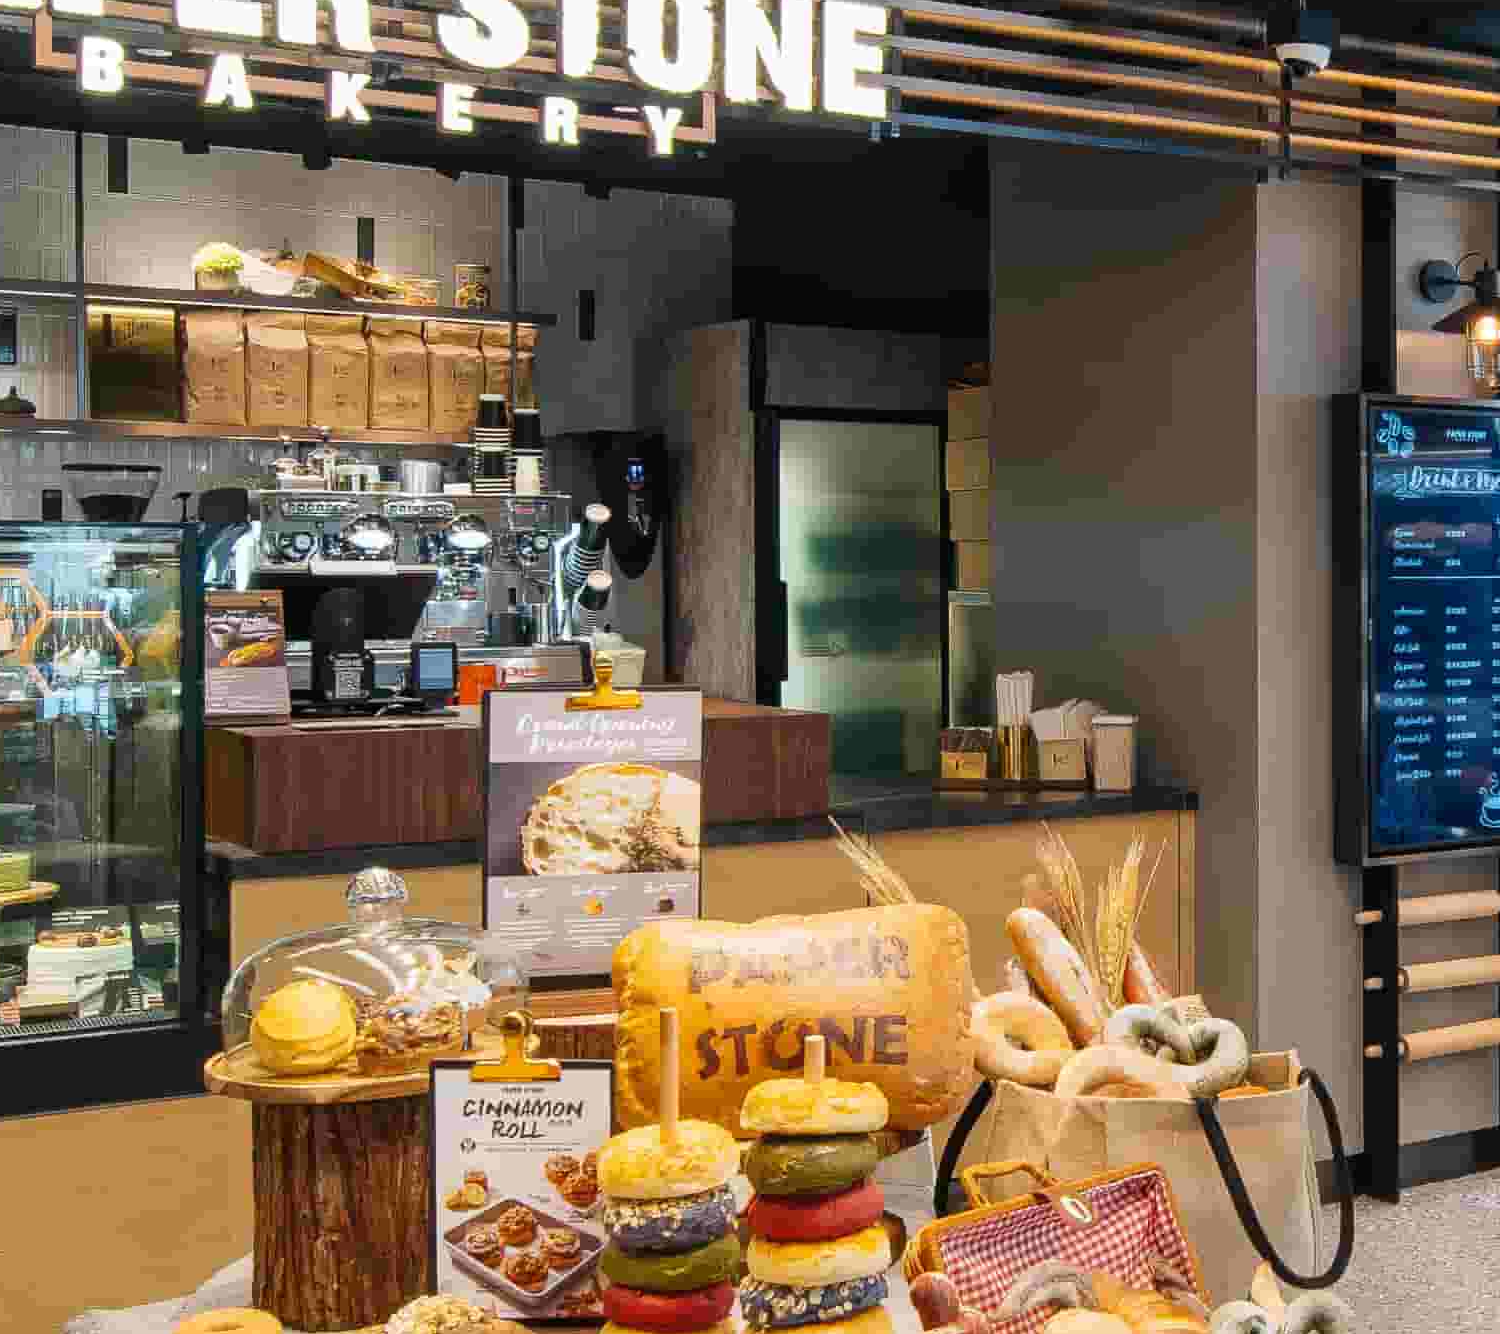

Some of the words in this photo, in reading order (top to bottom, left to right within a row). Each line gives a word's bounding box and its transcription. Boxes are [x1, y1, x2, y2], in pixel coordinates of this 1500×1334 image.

[78, 35, 685, 157] BAKERY
[694, 1013, 909, 1081] STONE
[461, 1098, 584, 1119] CINNAMON
[490, 1119, 545, 1139] ROLL
